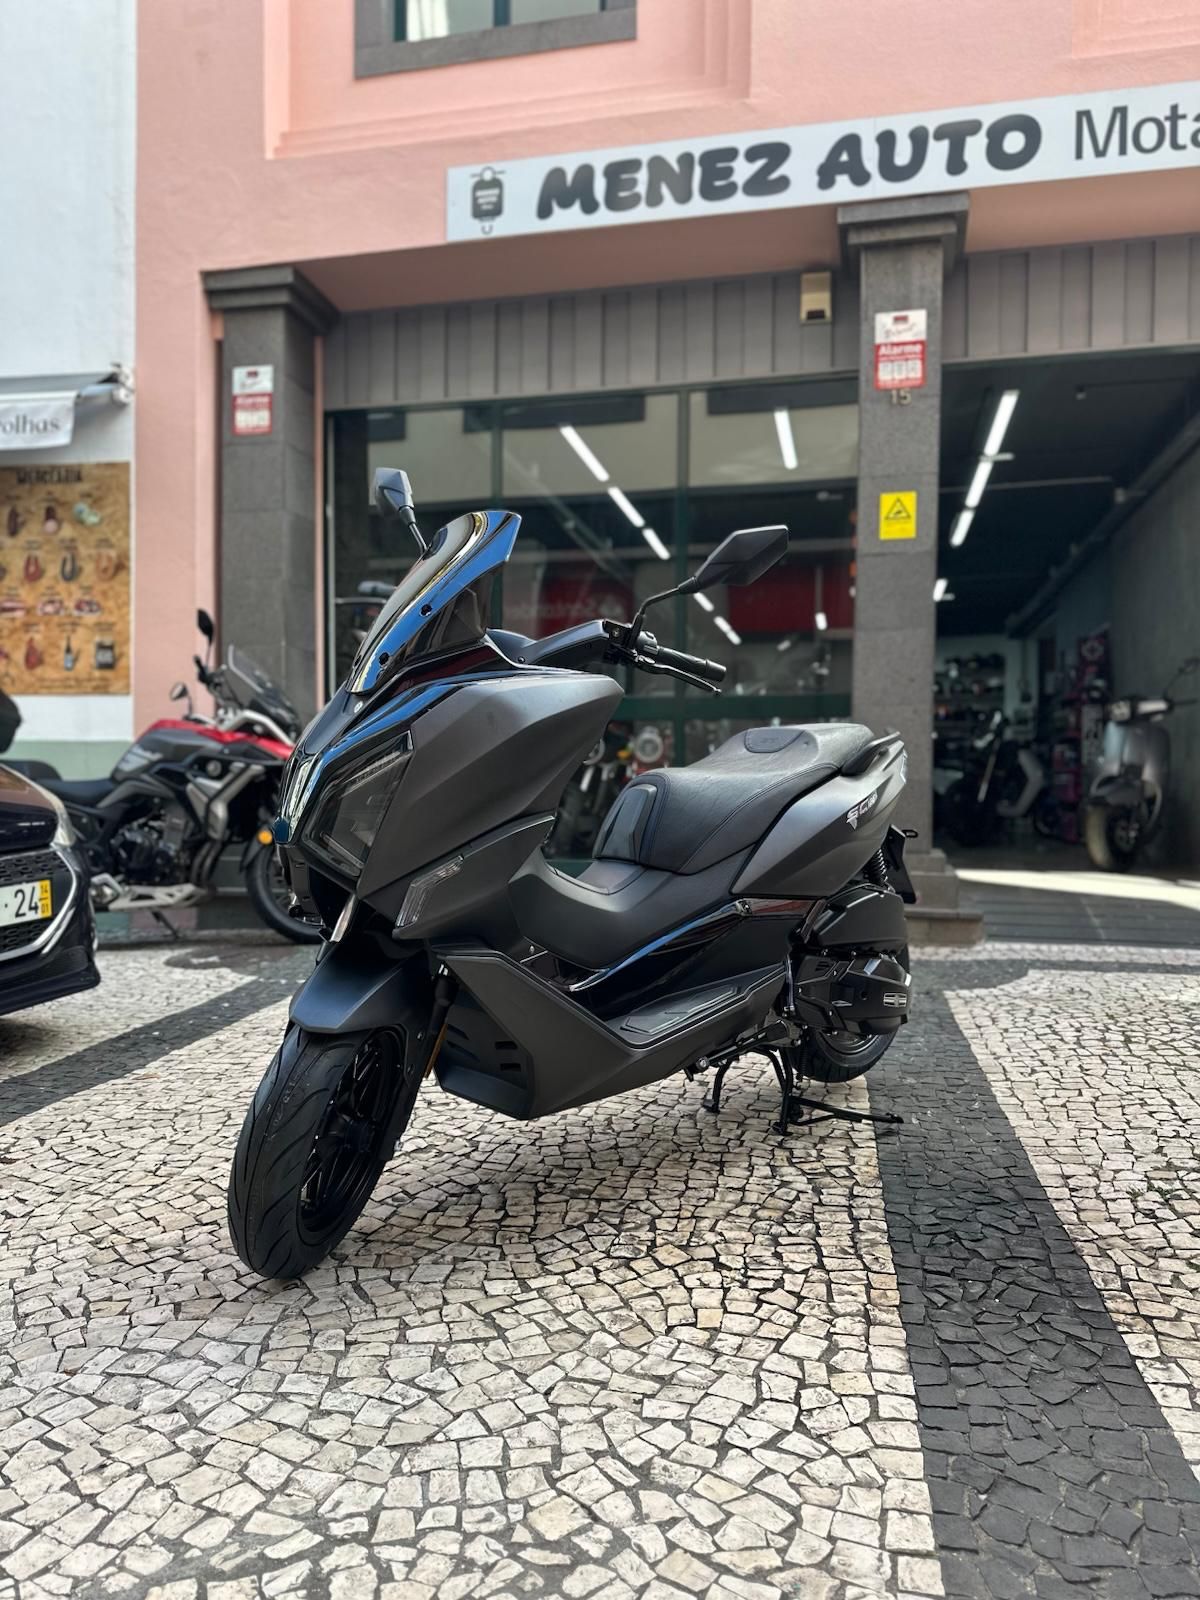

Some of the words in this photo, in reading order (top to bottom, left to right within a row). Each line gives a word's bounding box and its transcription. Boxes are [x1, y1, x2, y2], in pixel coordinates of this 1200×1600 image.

[536, 141, 792, 220] MENEZ
[816, 113, 1042, 191] AUTO
[891, 388, 912, 404] 15
[0, 413, 61, 434] olhas
